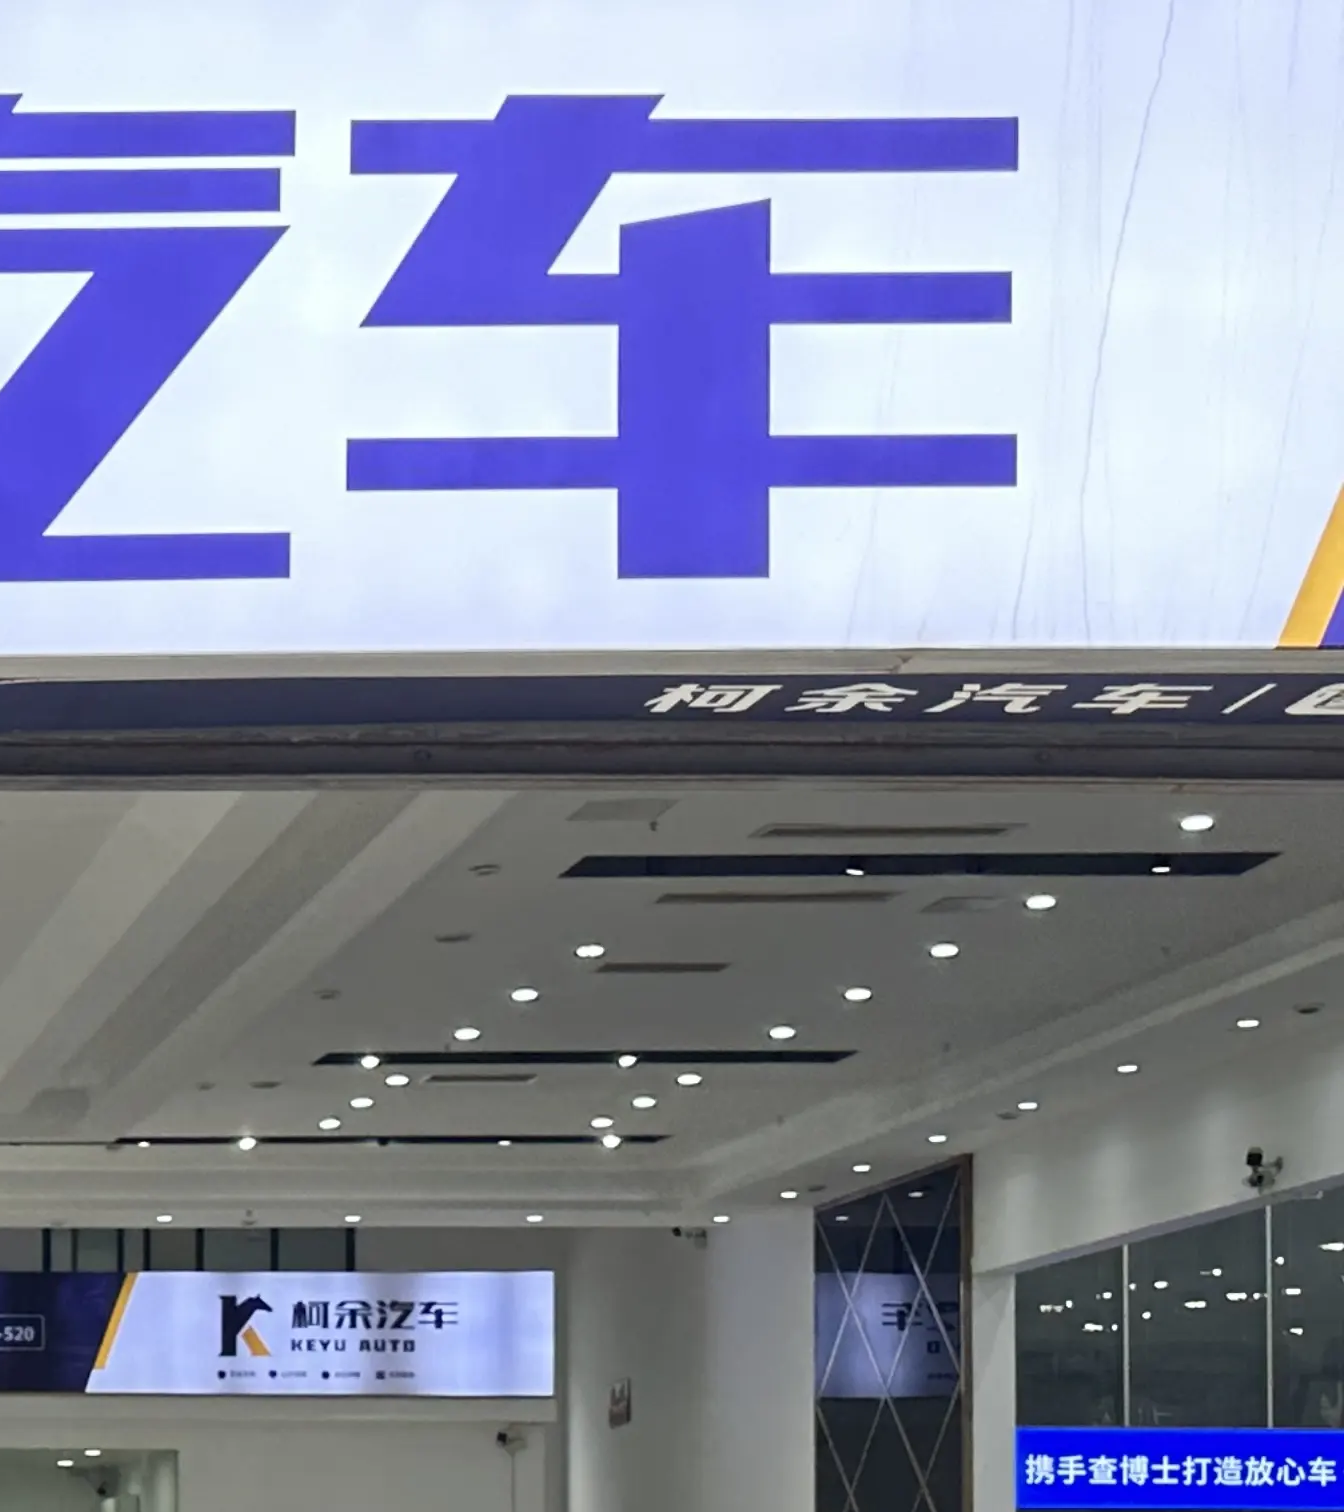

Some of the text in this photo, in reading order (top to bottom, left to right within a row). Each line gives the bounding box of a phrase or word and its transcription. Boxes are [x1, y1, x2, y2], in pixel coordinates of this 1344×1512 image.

[291, 1300, 458, 1330] 柯余汽车
[291, 1338, 416, 1352] KEYU AUTO
[1025, 1454, 1338, 1487] 携手查博士打造放心车
